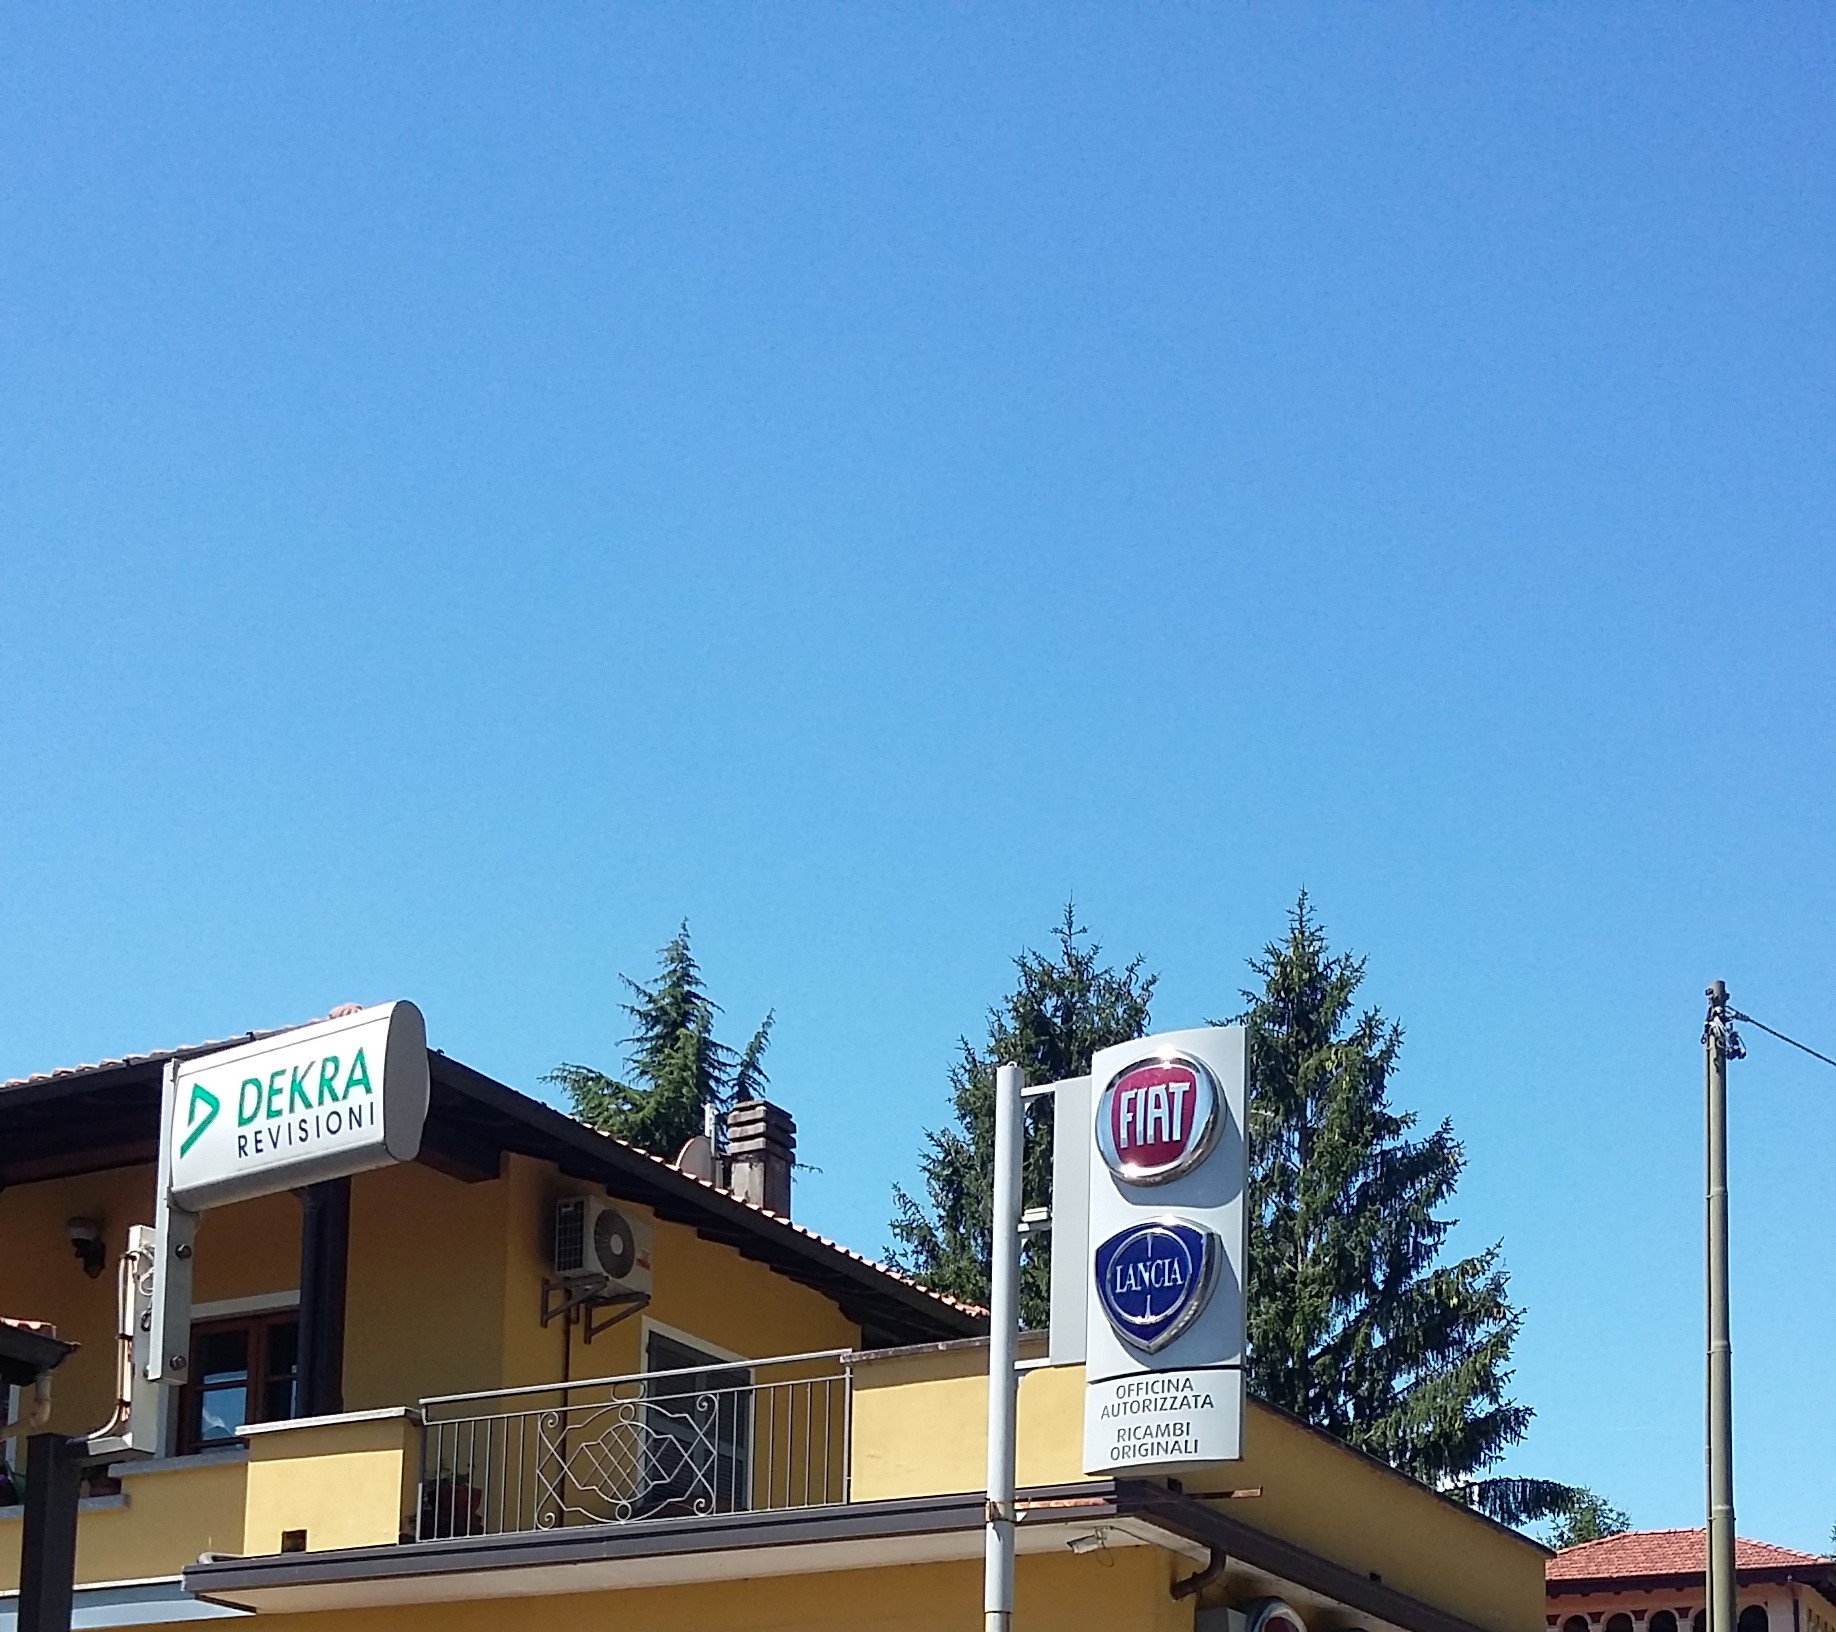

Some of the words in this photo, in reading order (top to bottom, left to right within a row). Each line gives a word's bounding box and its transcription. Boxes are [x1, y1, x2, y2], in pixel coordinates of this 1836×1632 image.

[237, 1047, 374, 1128] DEKRA
[237, 1101, 375, 1158] REVISIONI
[1119, 1082, 1191, 1149] FIAT
[1114, 1257, 1184, 1294] LANCIA
[1115, 1376, 1194, 1400] OFFICINA
[1100, 1393, 1215, 1421] AUTORIZZATA
[1116, 1421, 1191, 1444] RICAMBI
[1109, 1439, 1199, 1461] ORIGINALI
